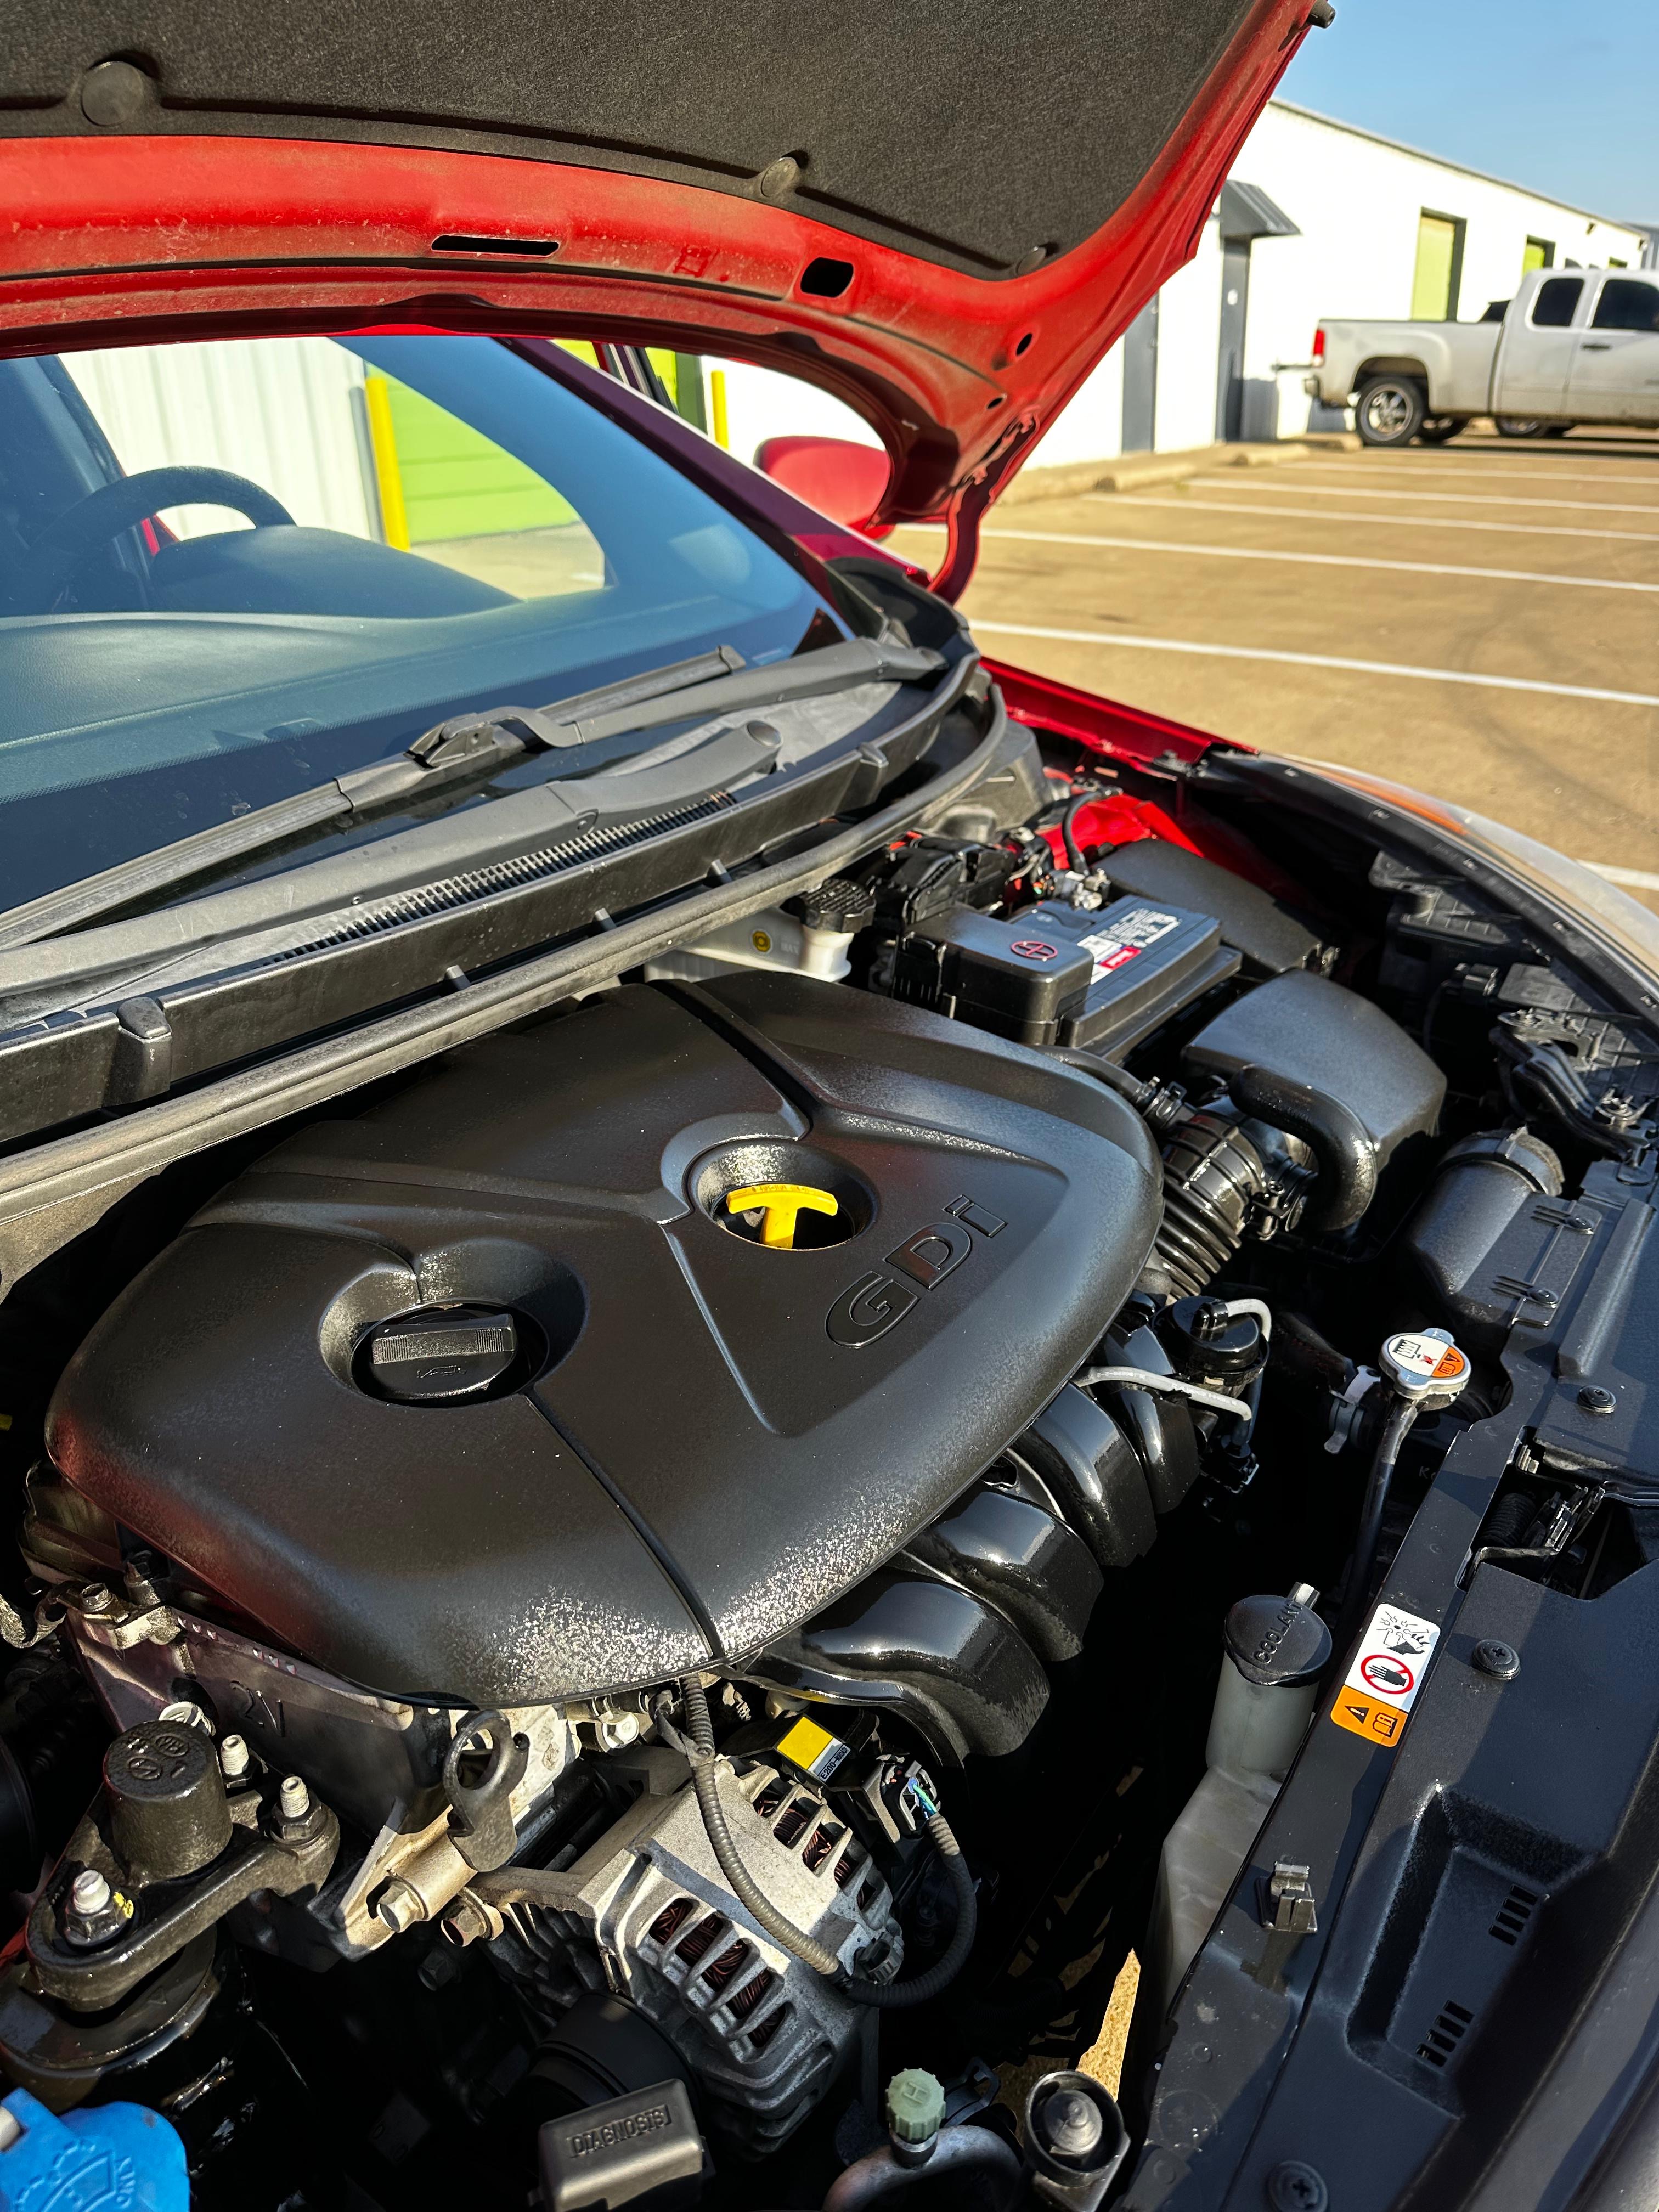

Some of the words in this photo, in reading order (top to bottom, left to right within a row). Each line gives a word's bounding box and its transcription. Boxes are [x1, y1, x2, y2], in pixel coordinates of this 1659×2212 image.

[1254, 1599, 1302, 1664] COOLANT
[902, 2081, 928, 2104] H
[571, 2108, 665, 2156] DIAGNOSIS
